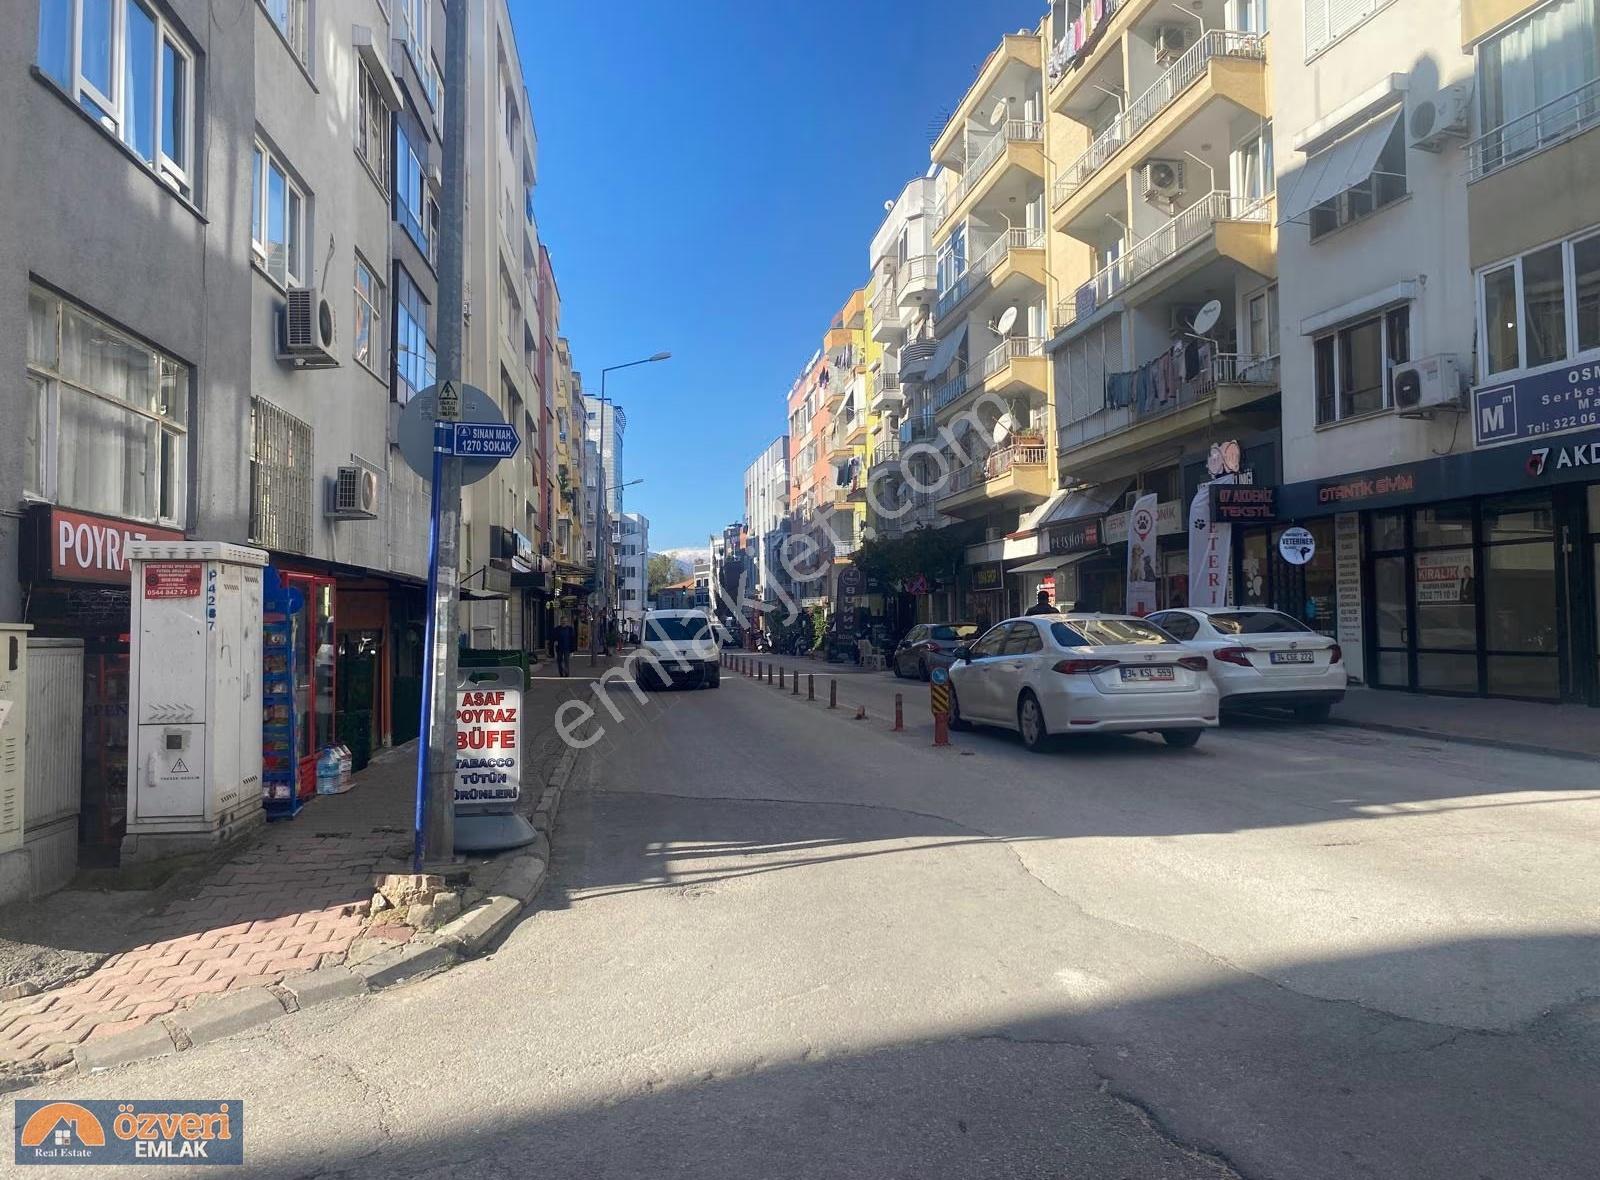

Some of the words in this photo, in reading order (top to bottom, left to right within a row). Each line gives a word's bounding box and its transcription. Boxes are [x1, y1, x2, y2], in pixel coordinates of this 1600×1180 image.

[1542, 386, 1600, 405] Serbe
[1528, 422, 1549, 434] Tel:
[1554, 416, 1577, 429] 322
[1580, 412, 1596, 424] 06
[462, 440, 481, 451] 1270
[483, 441, 512, 452] SOKAK
[1127, 669, 1137, 678] 34
[462, 692, 505, 706] ASAF
[456, 727, 516, 749] BÜFE
[456, 758, 515, 769] TABACCO
[461, 772, 507, 785] TÜTÜN
